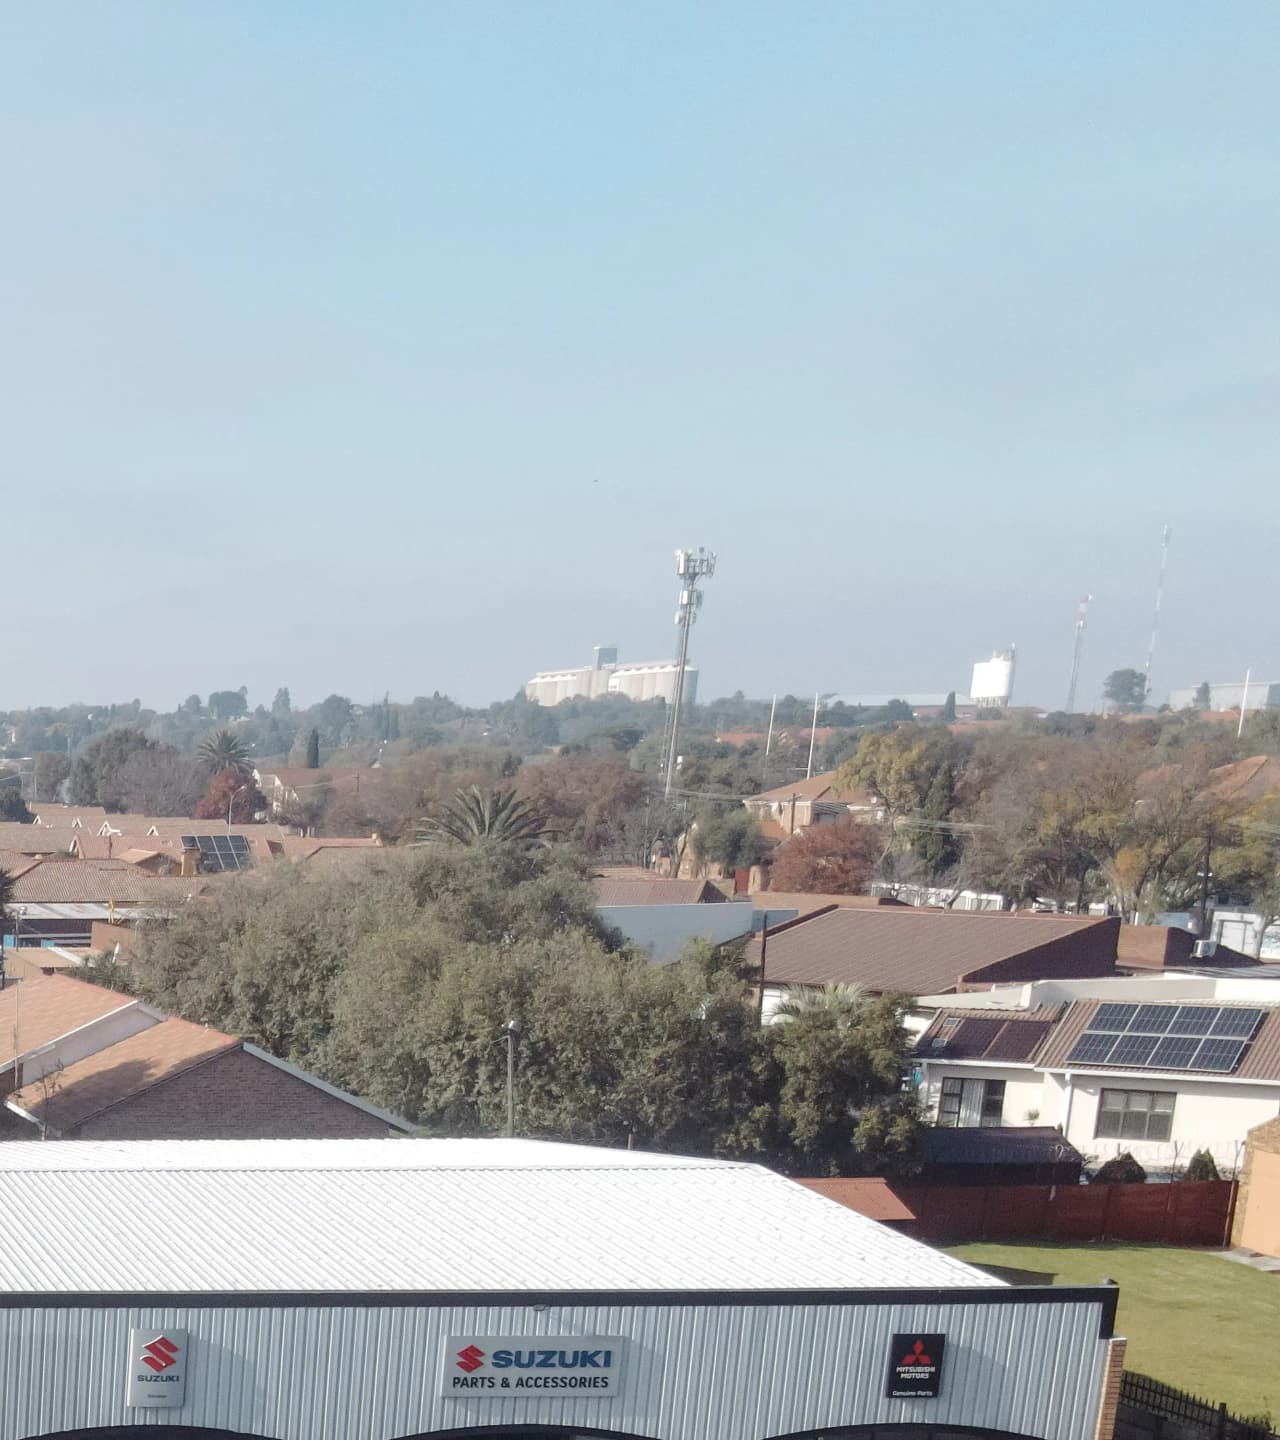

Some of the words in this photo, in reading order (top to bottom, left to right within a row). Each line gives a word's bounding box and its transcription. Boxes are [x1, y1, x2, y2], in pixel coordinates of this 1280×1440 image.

[491, 1350, 612, 1368] SUZUKI
[453, 1376, 495, 1388] PARTS
[500, 1376, 510, 1388] &
[515, 1376, 609, 1388] ACCESSORIES
